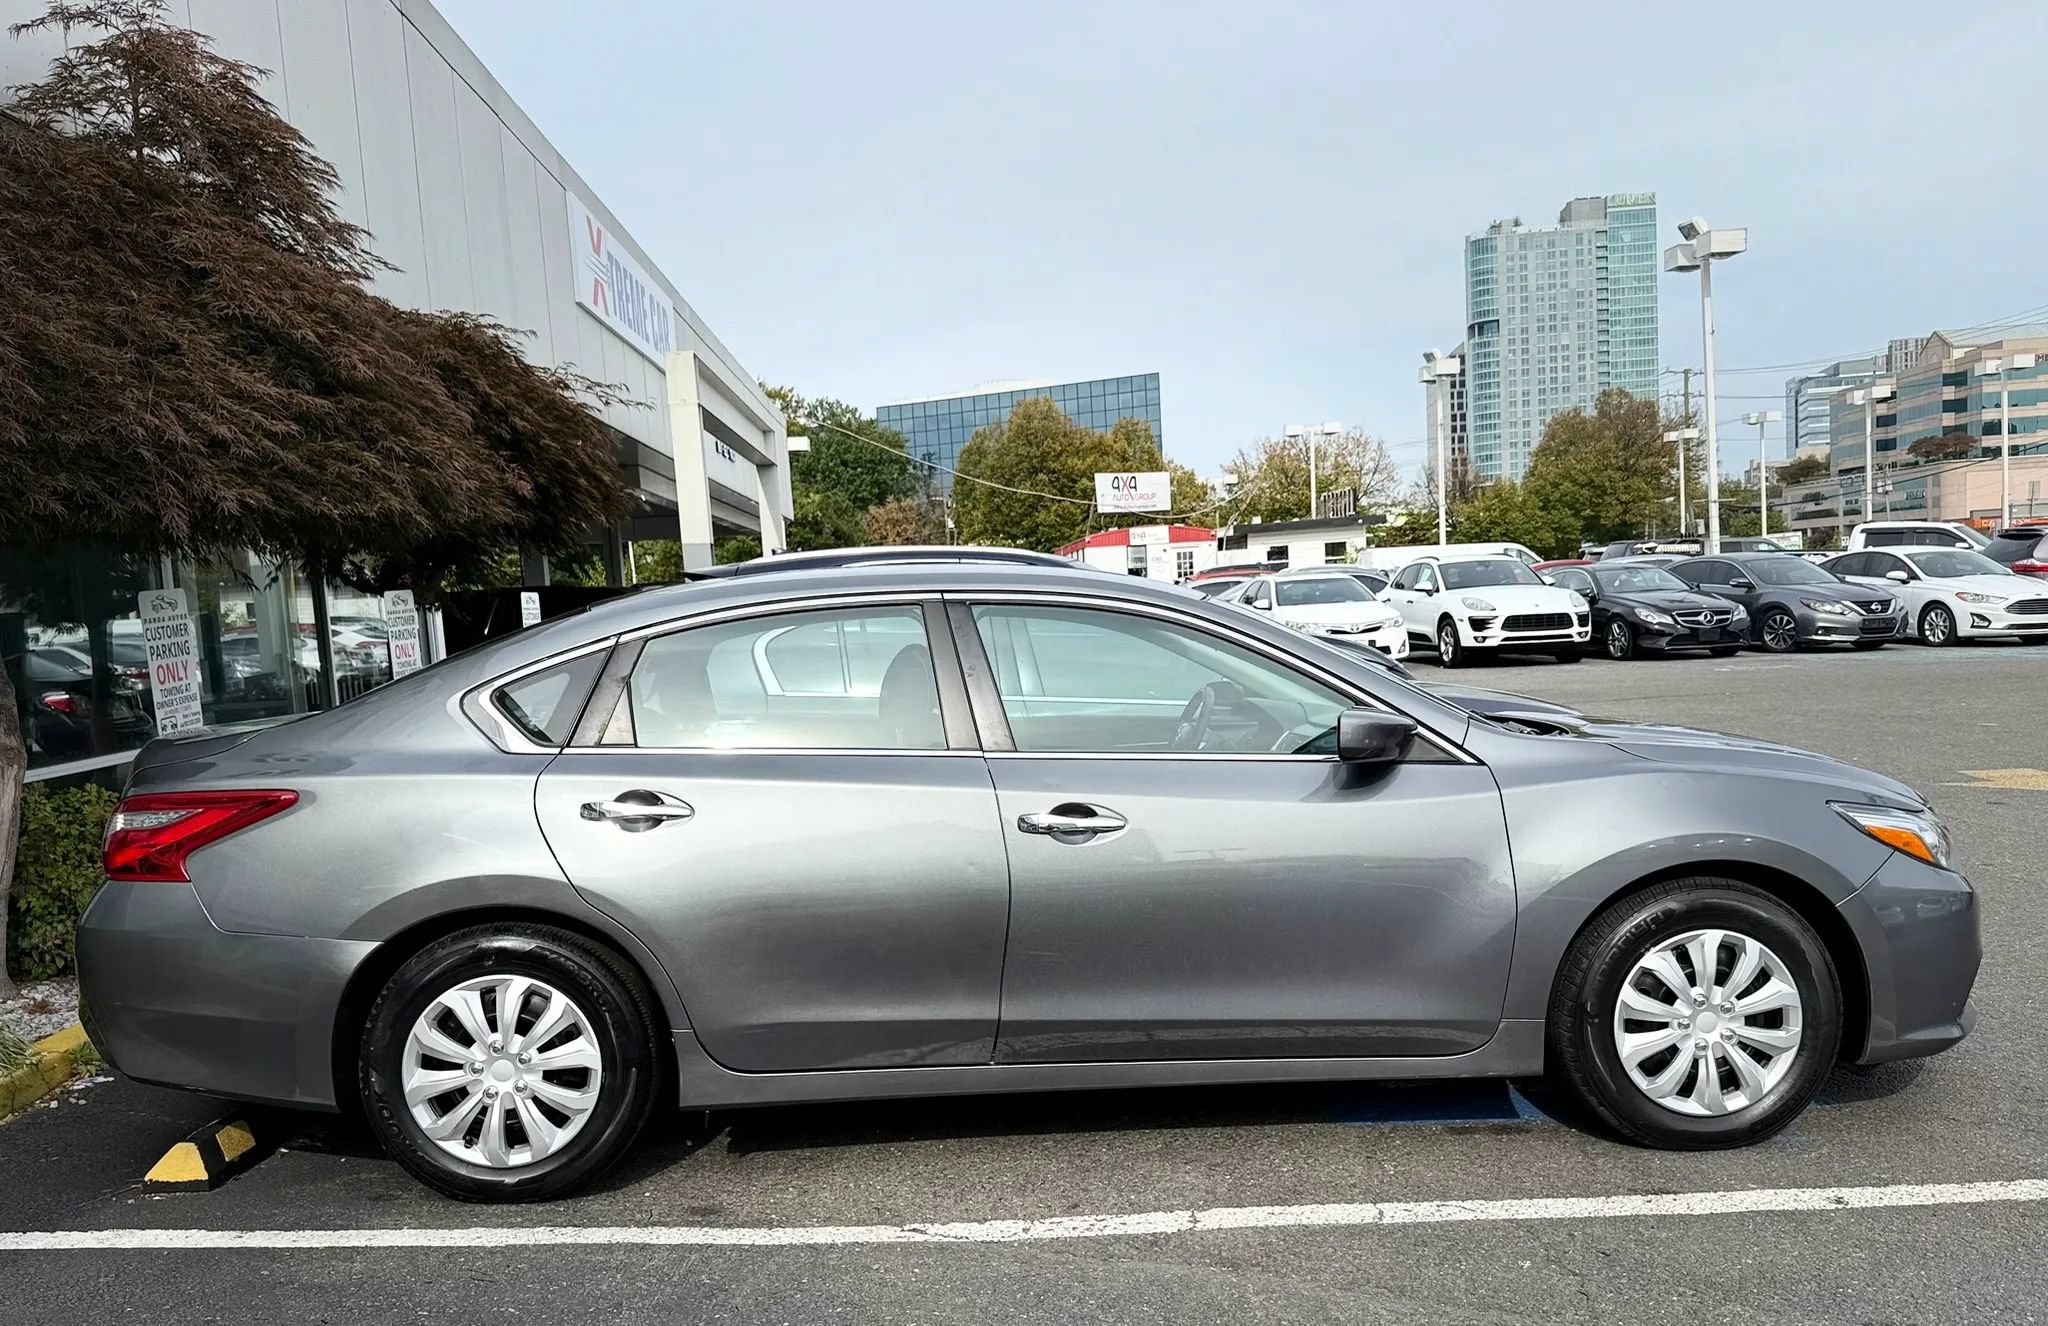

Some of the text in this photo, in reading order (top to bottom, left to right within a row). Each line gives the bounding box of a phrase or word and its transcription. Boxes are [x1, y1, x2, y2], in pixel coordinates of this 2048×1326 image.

[1609, 191, 1656, 206] LUMEN
[649, 293, 672, 355] CAR
[1134, 492, 1157, 501] GROUP
[143, 613, 188, 625] PANDA AUTOS
[387, 615, 415, 628] CUSTOMER
[145, 622, 190, 642] CUSTOMER
[390, 627, 417, 642] PARKING
[149, 640, 191, 662] PARKING
[394, 642, 416, 660] ONLY
[156, 659, 189, 686] ONLY
[160, 682, 192, 699] TOWING AT
[156, 697, 179, 710] OWNER'S
[178, 692, 199, 705] EXPENSE
